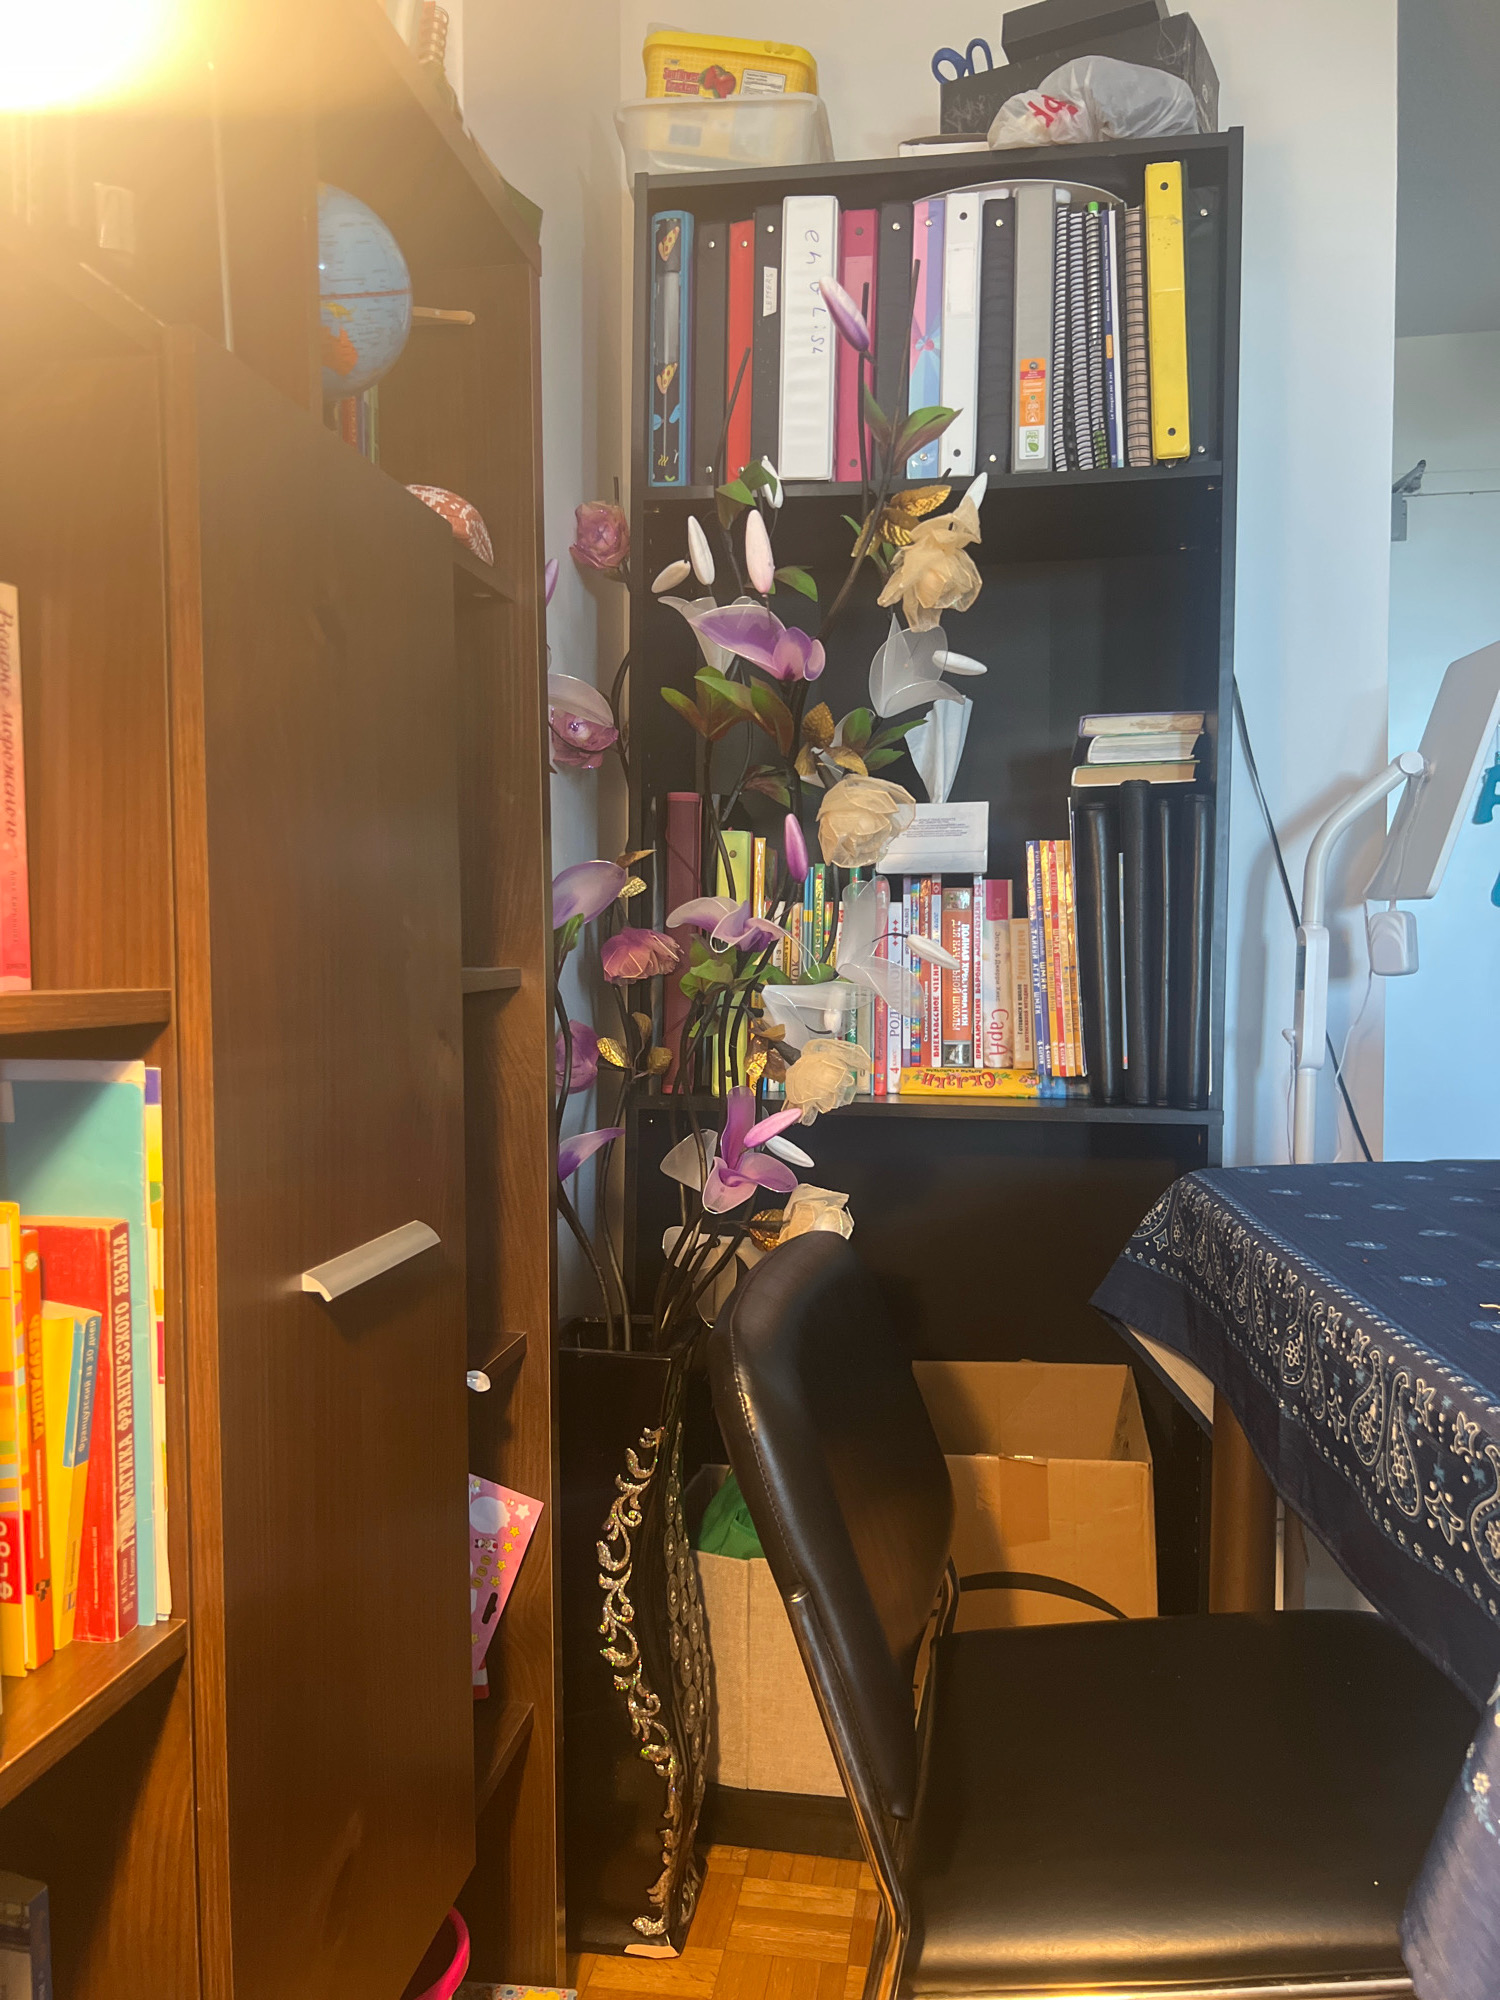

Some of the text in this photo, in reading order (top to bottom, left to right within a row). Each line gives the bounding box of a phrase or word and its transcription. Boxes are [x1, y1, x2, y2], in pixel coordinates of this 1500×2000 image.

[889, 1067, 900, 1075] 4
[87, 1319, 98, 1347] дней
[86, 1349, 95, 1363] 30
[28, 1314, 44, 1441] ЧЕБУРАШКА
[112, 1231, 136, 1553] ГРАММАТИКА ФРАНЦУЗСКОГО ЯЗЫКА
